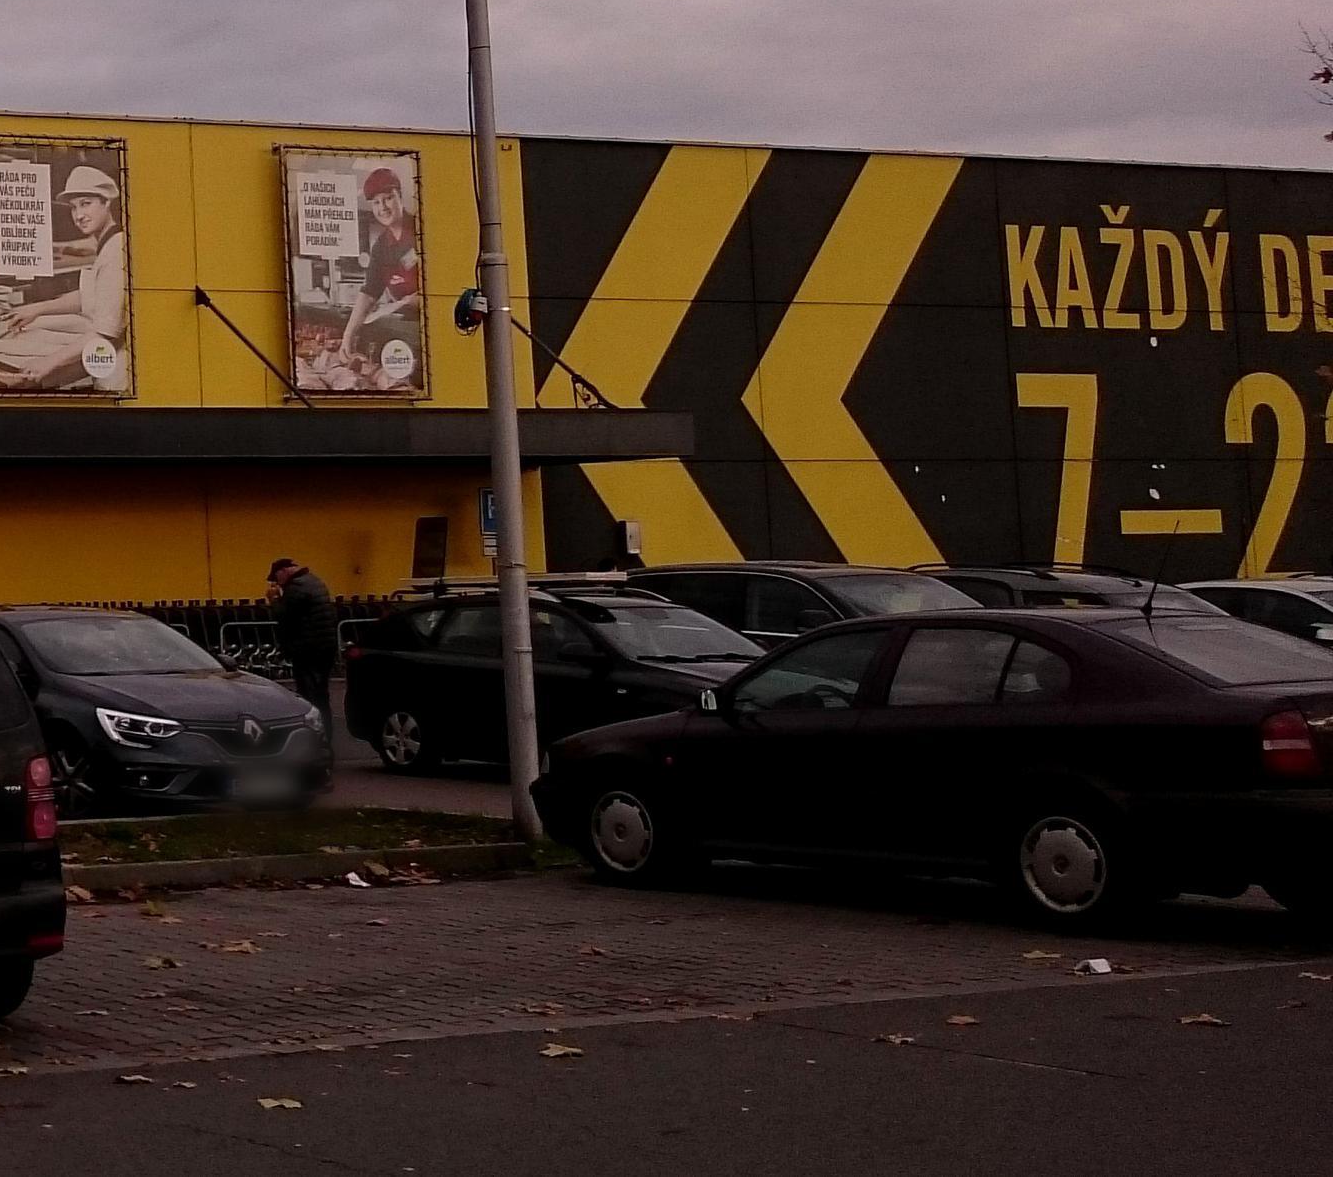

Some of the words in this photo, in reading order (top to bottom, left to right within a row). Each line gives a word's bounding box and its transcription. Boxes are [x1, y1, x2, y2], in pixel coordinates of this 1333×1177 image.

[21, 173, 37, 184] PRO
[0, 184, 14, 196] VÁS
[15, 185, 35, 197] PEČU
[310, 180, 336, 193] NAŠICH
[0, 198, 45, 211] NĚKOLIKRÁT
[0, 212, 25, 224] DENNĚ
[27, 213, 45, 225] VAŠE
[1, 225, 37, 239] OBLÍBENÉ
[1, 239, 36, 252] KŘUPAVÉ
[1004, 204, 1230, 332] KAŽDÝ
[85, 353, 114, 364] albert
